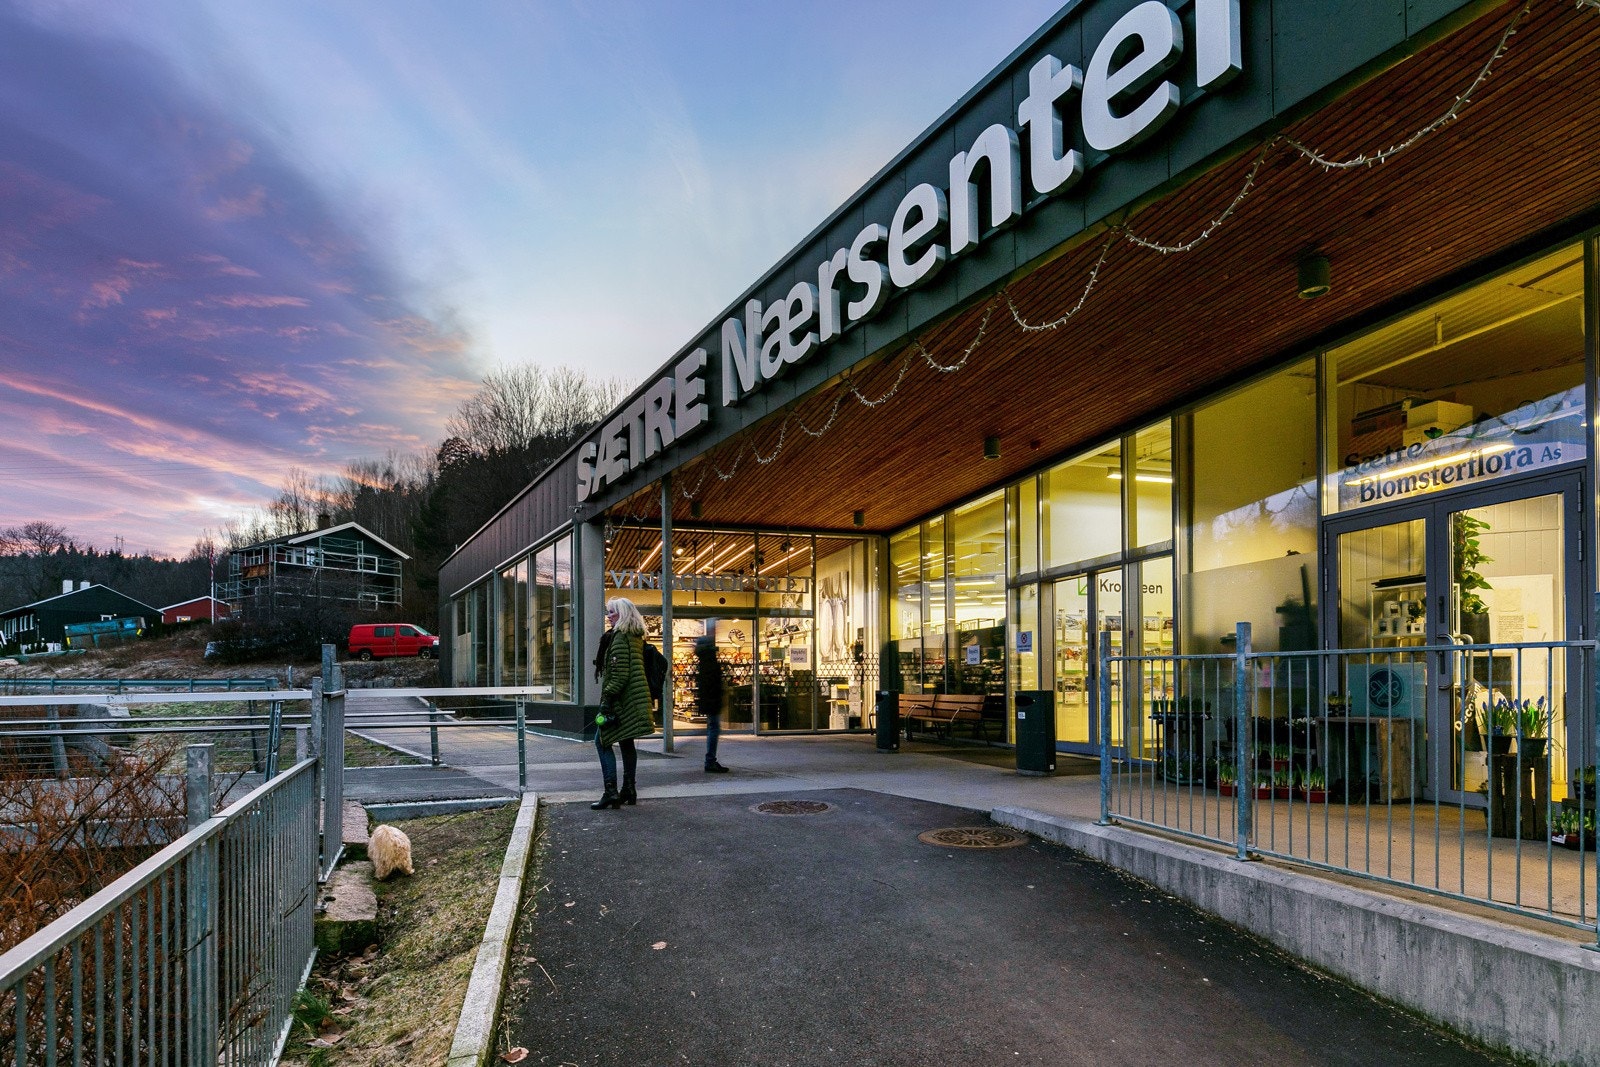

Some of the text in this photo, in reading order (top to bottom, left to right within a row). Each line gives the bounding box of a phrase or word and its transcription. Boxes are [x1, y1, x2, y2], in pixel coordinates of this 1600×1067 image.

[577, 347, 709, 502] SÆTRE
[1344, 442, 1423, 474] Sætre
[1359, 446, 1562, 503] Blomsterflora As
[1099, 579, 1163, 594] Kroeen
